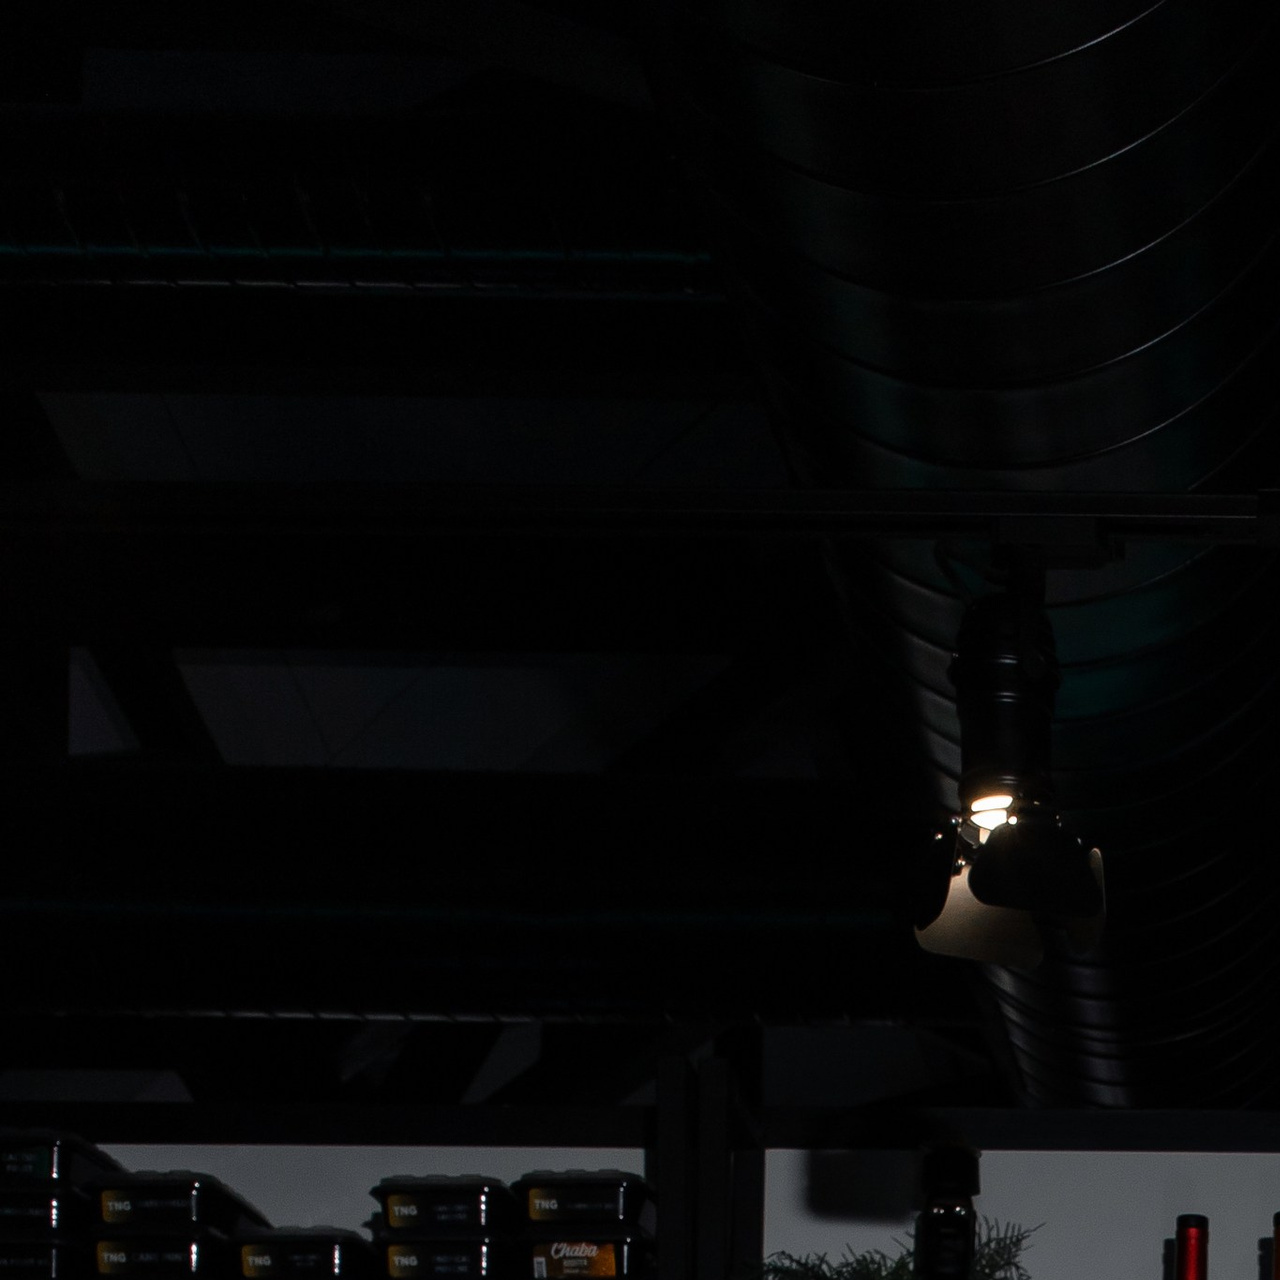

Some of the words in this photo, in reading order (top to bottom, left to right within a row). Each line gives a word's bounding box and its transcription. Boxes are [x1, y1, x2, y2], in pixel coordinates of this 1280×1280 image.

[107, 1200, 132, 1211] TNG
[535, 1199, 558, 1209] TNG
[393, 1206, 418, 1216] TNG
[550, 1241, 599, 1259] Chaba
[103, 1252, 127, 1263] TNG
[248, 1256, 271, 1266] TNG
[393, 1256, 418, 1266] TNG
